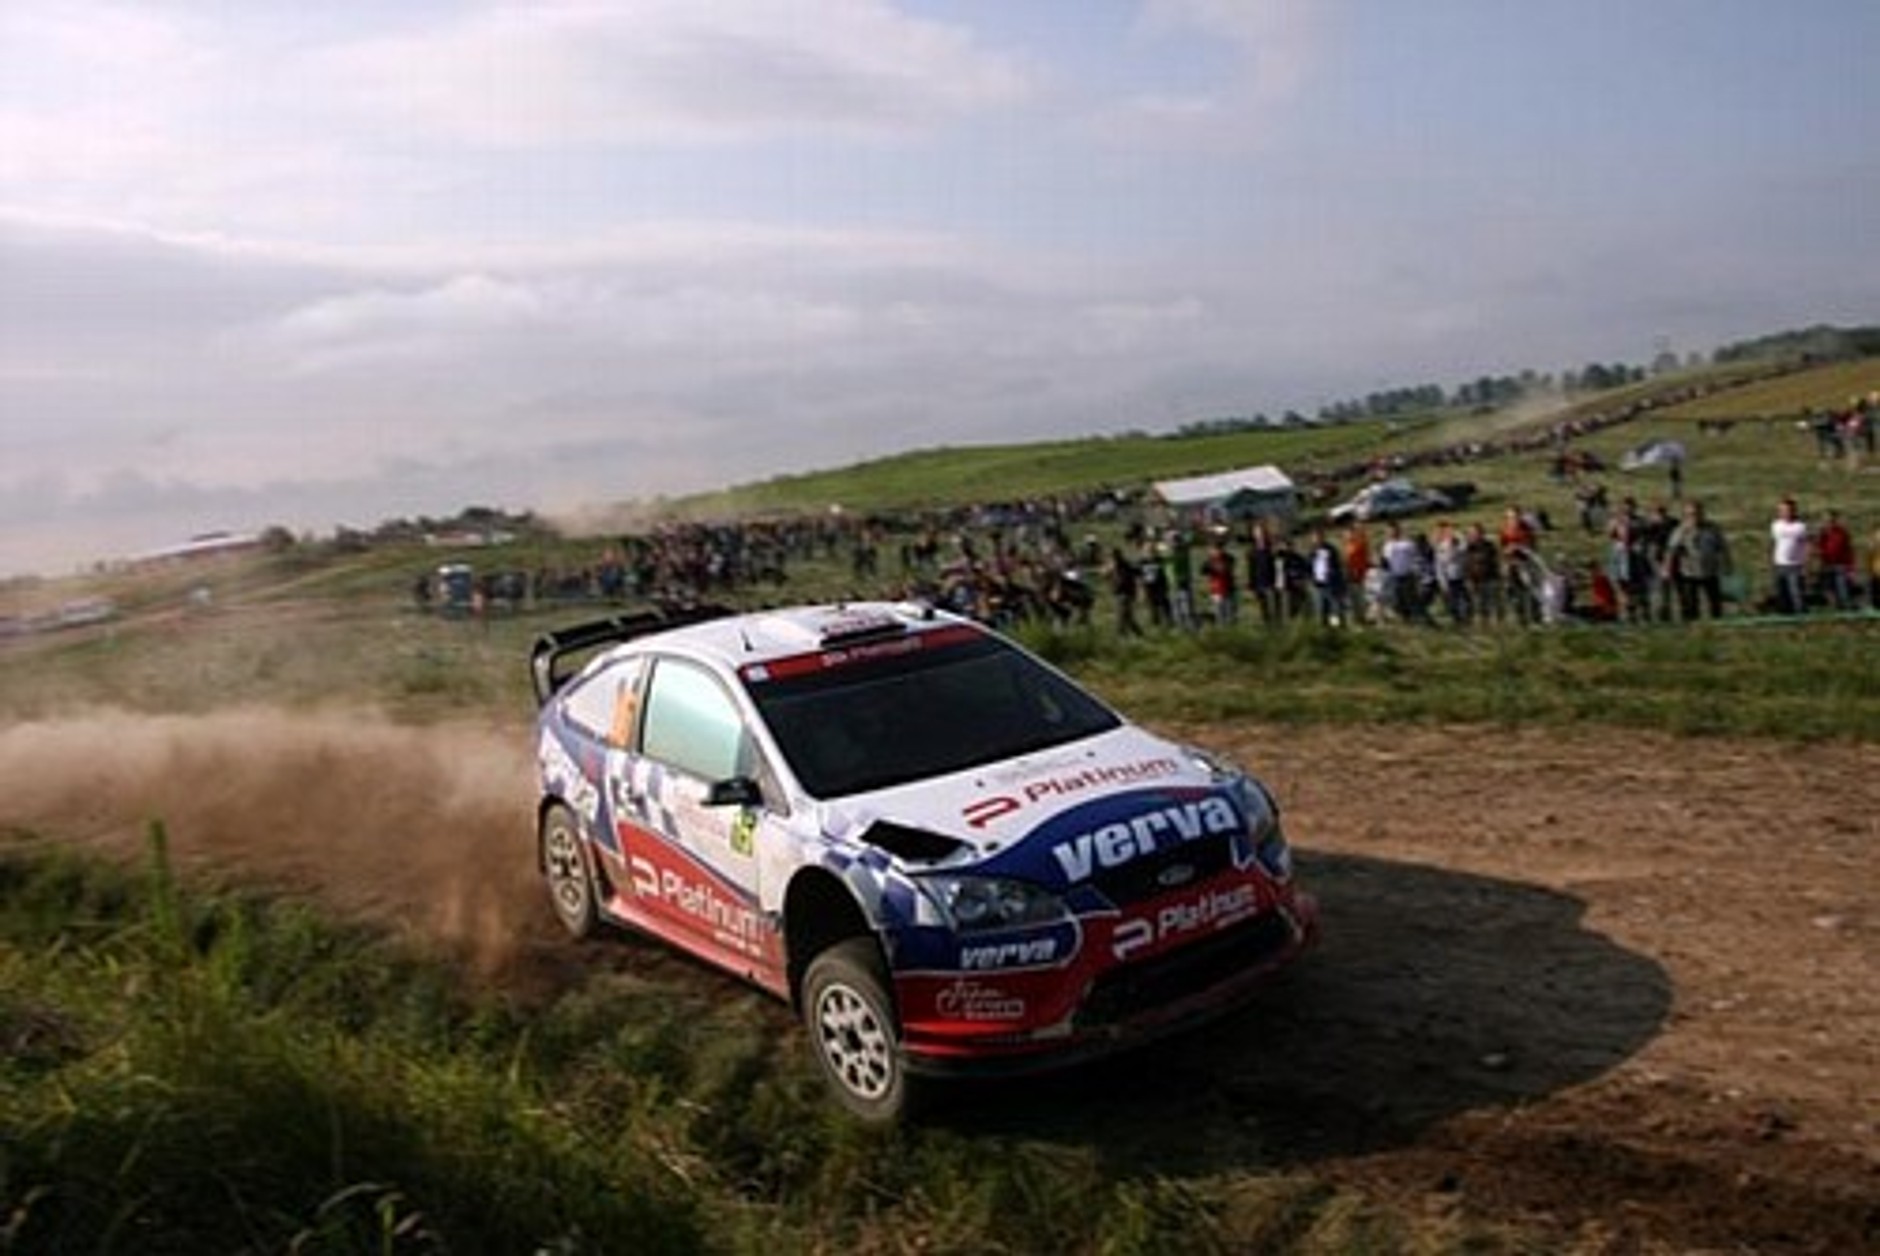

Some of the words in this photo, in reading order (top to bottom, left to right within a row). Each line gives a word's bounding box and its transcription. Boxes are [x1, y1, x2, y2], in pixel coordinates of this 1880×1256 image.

[1023, 758, 1179, 802] Platinum
[1052, 796, 1240, 883] verva
[961, 939, 1056, 969] verva
